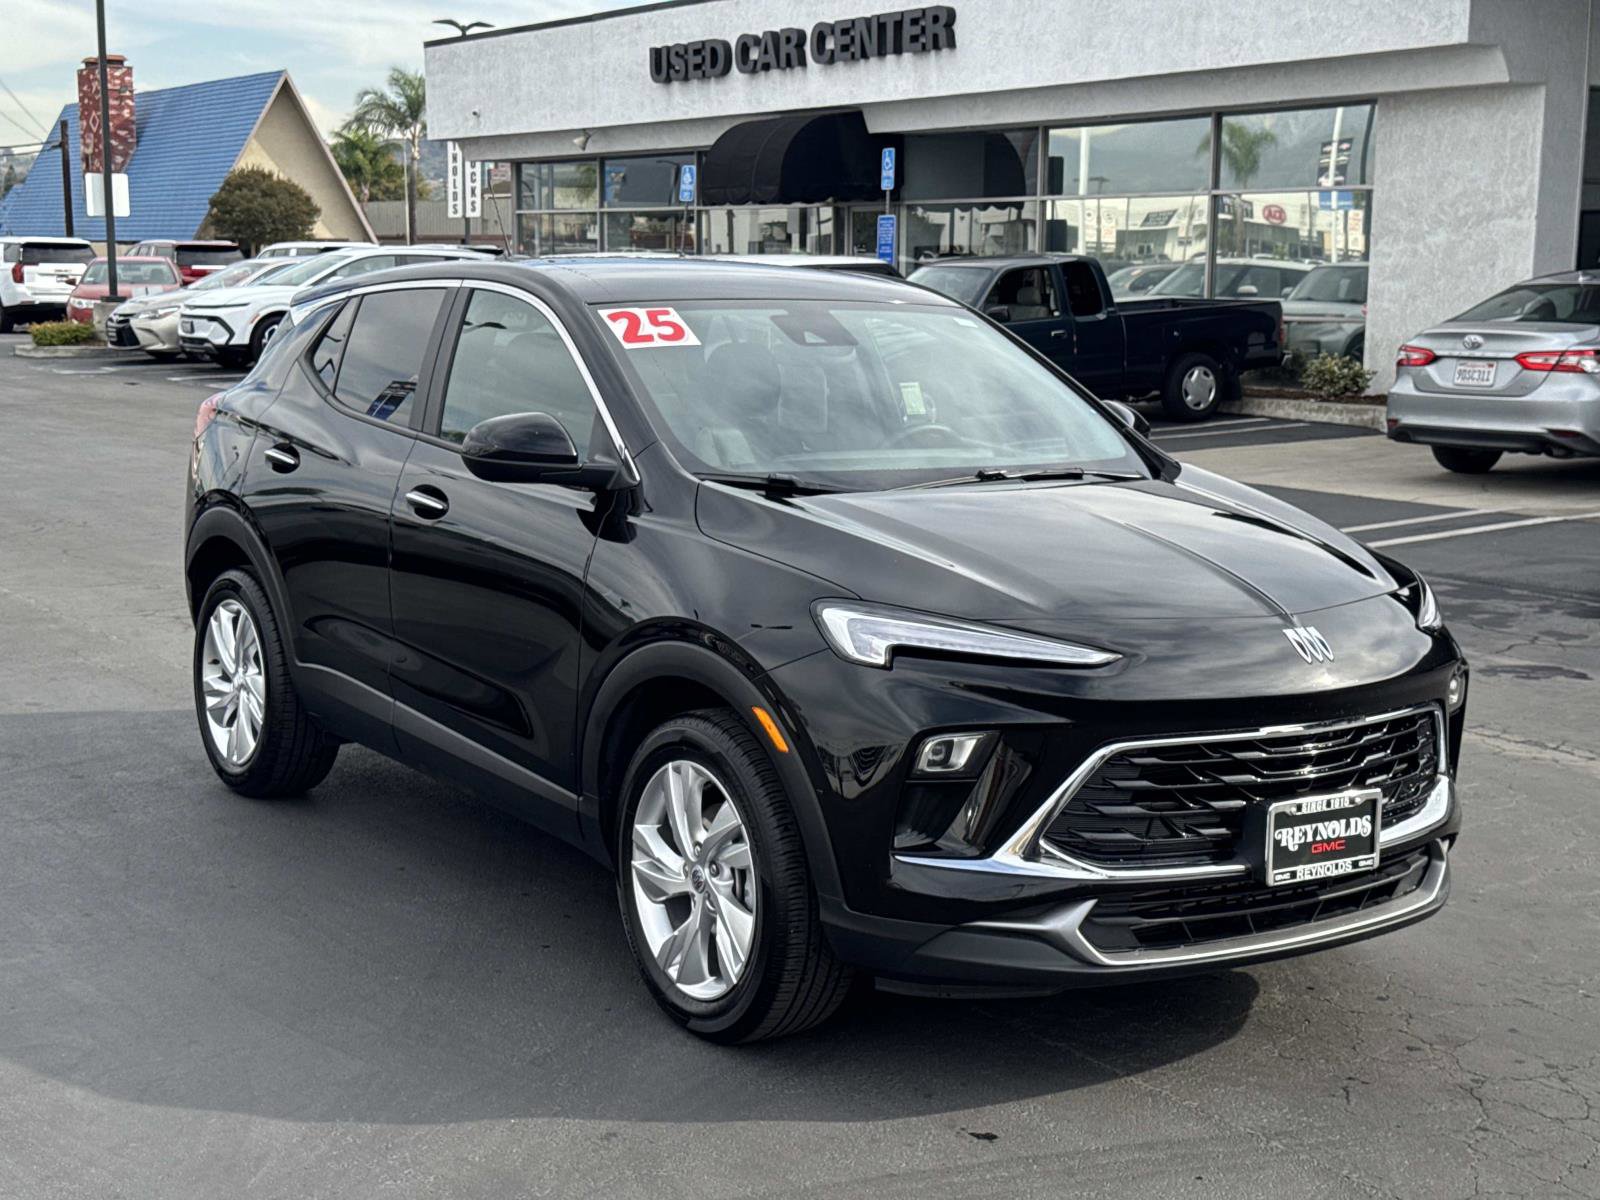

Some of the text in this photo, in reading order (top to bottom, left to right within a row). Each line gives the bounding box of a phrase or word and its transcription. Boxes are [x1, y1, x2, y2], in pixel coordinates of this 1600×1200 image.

[649, 5, 957, 83] USED CAR CENTER
[607, 309, 686, 344] 25
[1274, 815, 1372, 852] REYNOLDS
[1311, 840, 1346, 854] GMC
[1296, 861, 1352, 880] REYNOLDS
